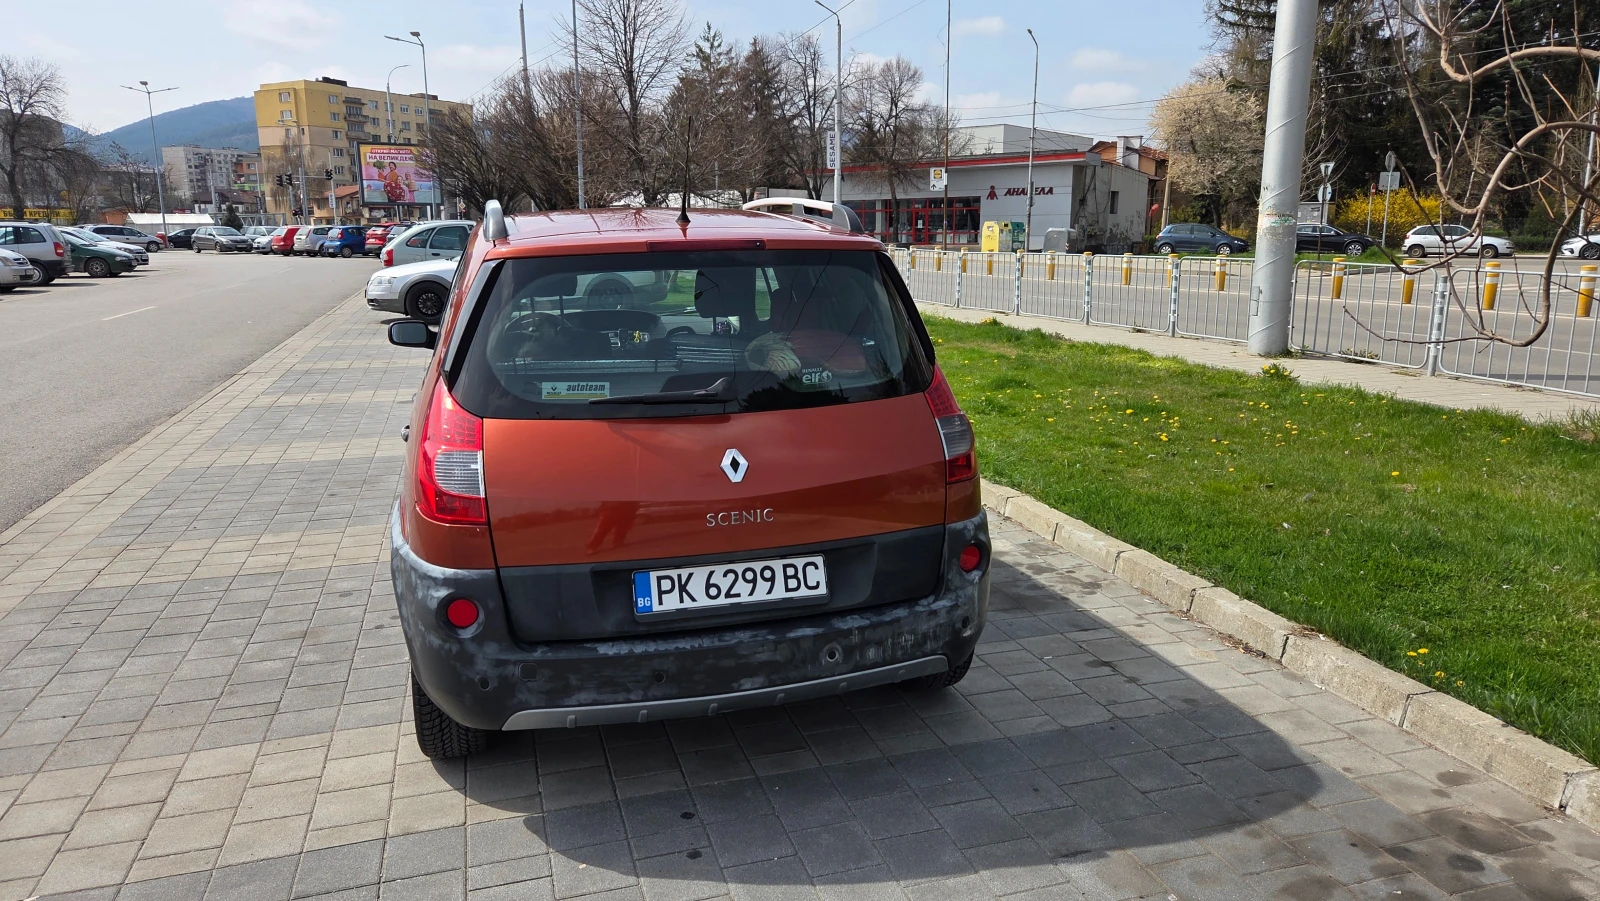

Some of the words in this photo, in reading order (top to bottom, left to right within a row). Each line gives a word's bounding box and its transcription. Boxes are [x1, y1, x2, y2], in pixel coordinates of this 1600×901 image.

[1004, 186, 1054, 197] АНАЕЛА
[802, 372, 821, 383] elf
[566, 382, 606, 392] autoteam
[706, 507, 774, 527] SCENIC
[655, 571, 698, 606] PK
[704, 564, 776, 601] 6299
[781, 561, 821, 593] BC
[637, 597, 651, 607] BG
